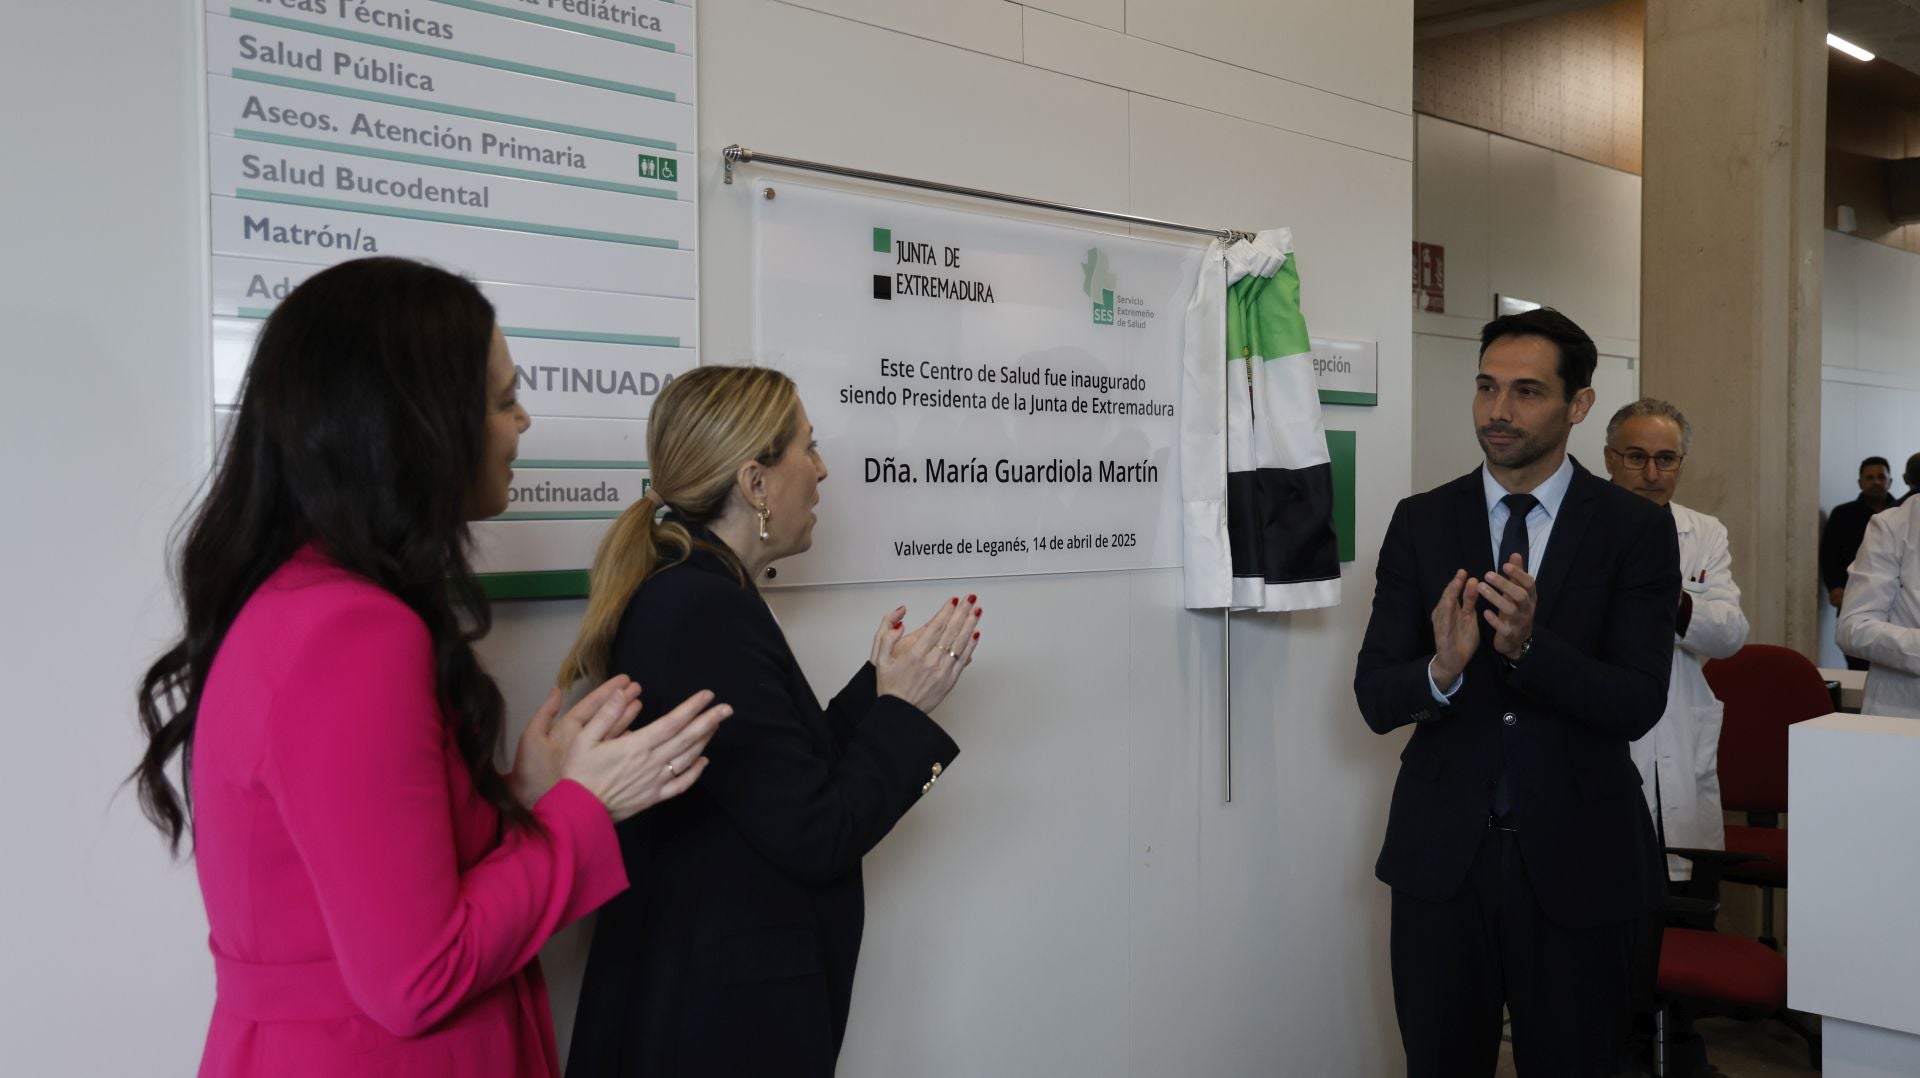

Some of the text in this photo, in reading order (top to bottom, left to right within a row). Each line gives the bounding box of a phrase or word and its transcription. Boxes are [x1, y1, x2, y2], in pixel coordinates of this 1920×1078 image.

[338, 0, 455, 40] Técnicas
[238, 34, 435, 92] Salud Pública
[241, 95, 587, 170] Aseos. Atención Primaria
[241, 154, 490, 208] Salud Bucodental
[243, 215, 379, 252] Matrón/a
[896, 240, 961, 269] JUNTA DE
[896, 272, 995, 304] EXTREMADURA
[1116, 295, 1144, 306] Servicio
[1094, 308, 1113, 322] SES
[1117, 307, 1155, 318] Extremeño
[1117, 318, 1147, 329] de Salud
[880, 358, 1146, 393] Este Centro de Salud fue inaugurado
[1312, 355, 1351, 377] epción
[840, 385, 1175, 417] siendo Presidenta de la Junta de Extremadura
[864, 456, 1159, 484] Dña. María Guardiola Martín
[508, 481, 620, 502] ontinuada
[894, 533, 1137, 558] Valverde de Leganés, 14 de abril de 2025
